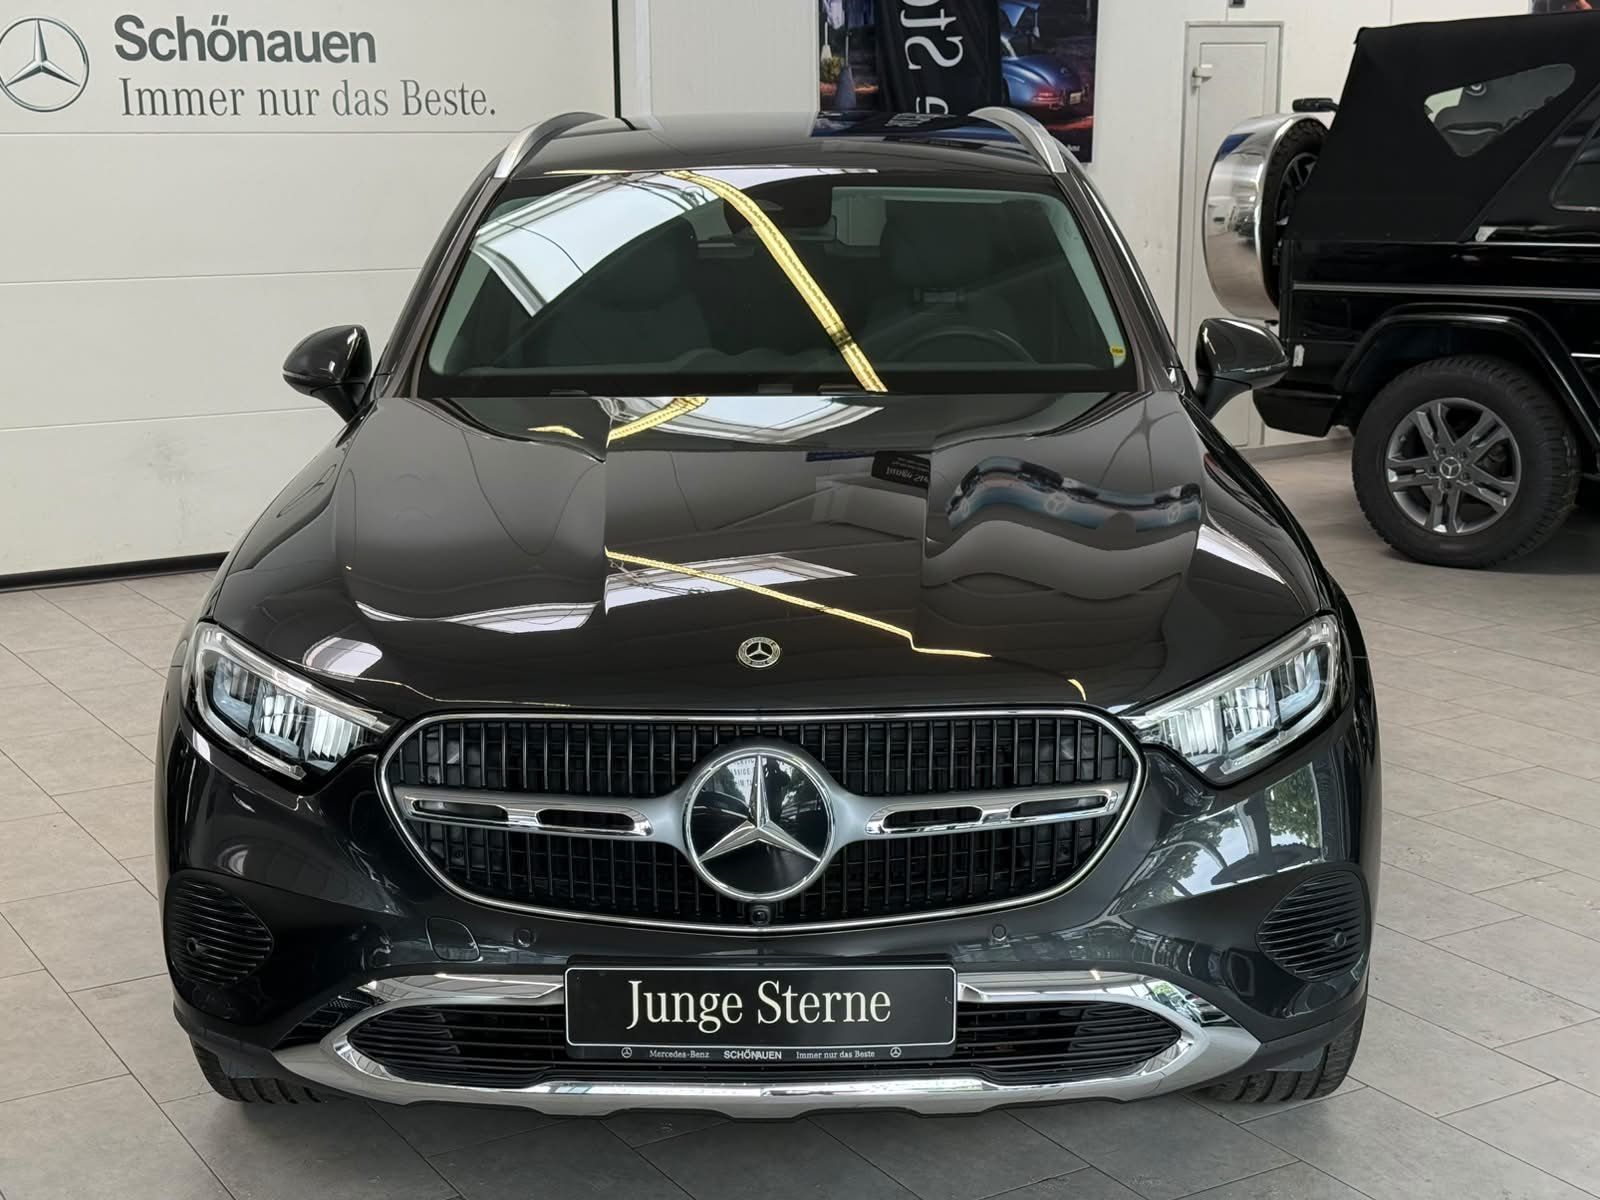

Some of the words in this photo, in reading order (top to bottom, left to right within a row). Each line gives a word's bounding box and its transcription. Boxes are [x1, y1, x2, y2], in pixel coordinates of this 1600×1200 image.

[114, 14, 377, 64] Schönauen
[119, 77, 244, 117] Immer
[257, 88, 321, 117] nur
[332, 80, 389, 117] das
[400, 79, 496, 117] Beste.
[626, 980, 743, 1033] Junge
[757, 980, 891, 1024] Sterne
[723, 1048, 782, 1060] SCHÖNAUEN
[796, 1051, 822, 1059] Immer
[840, 1050, 853, 1059] das
[855, 1049, 876, 1058] Beste
